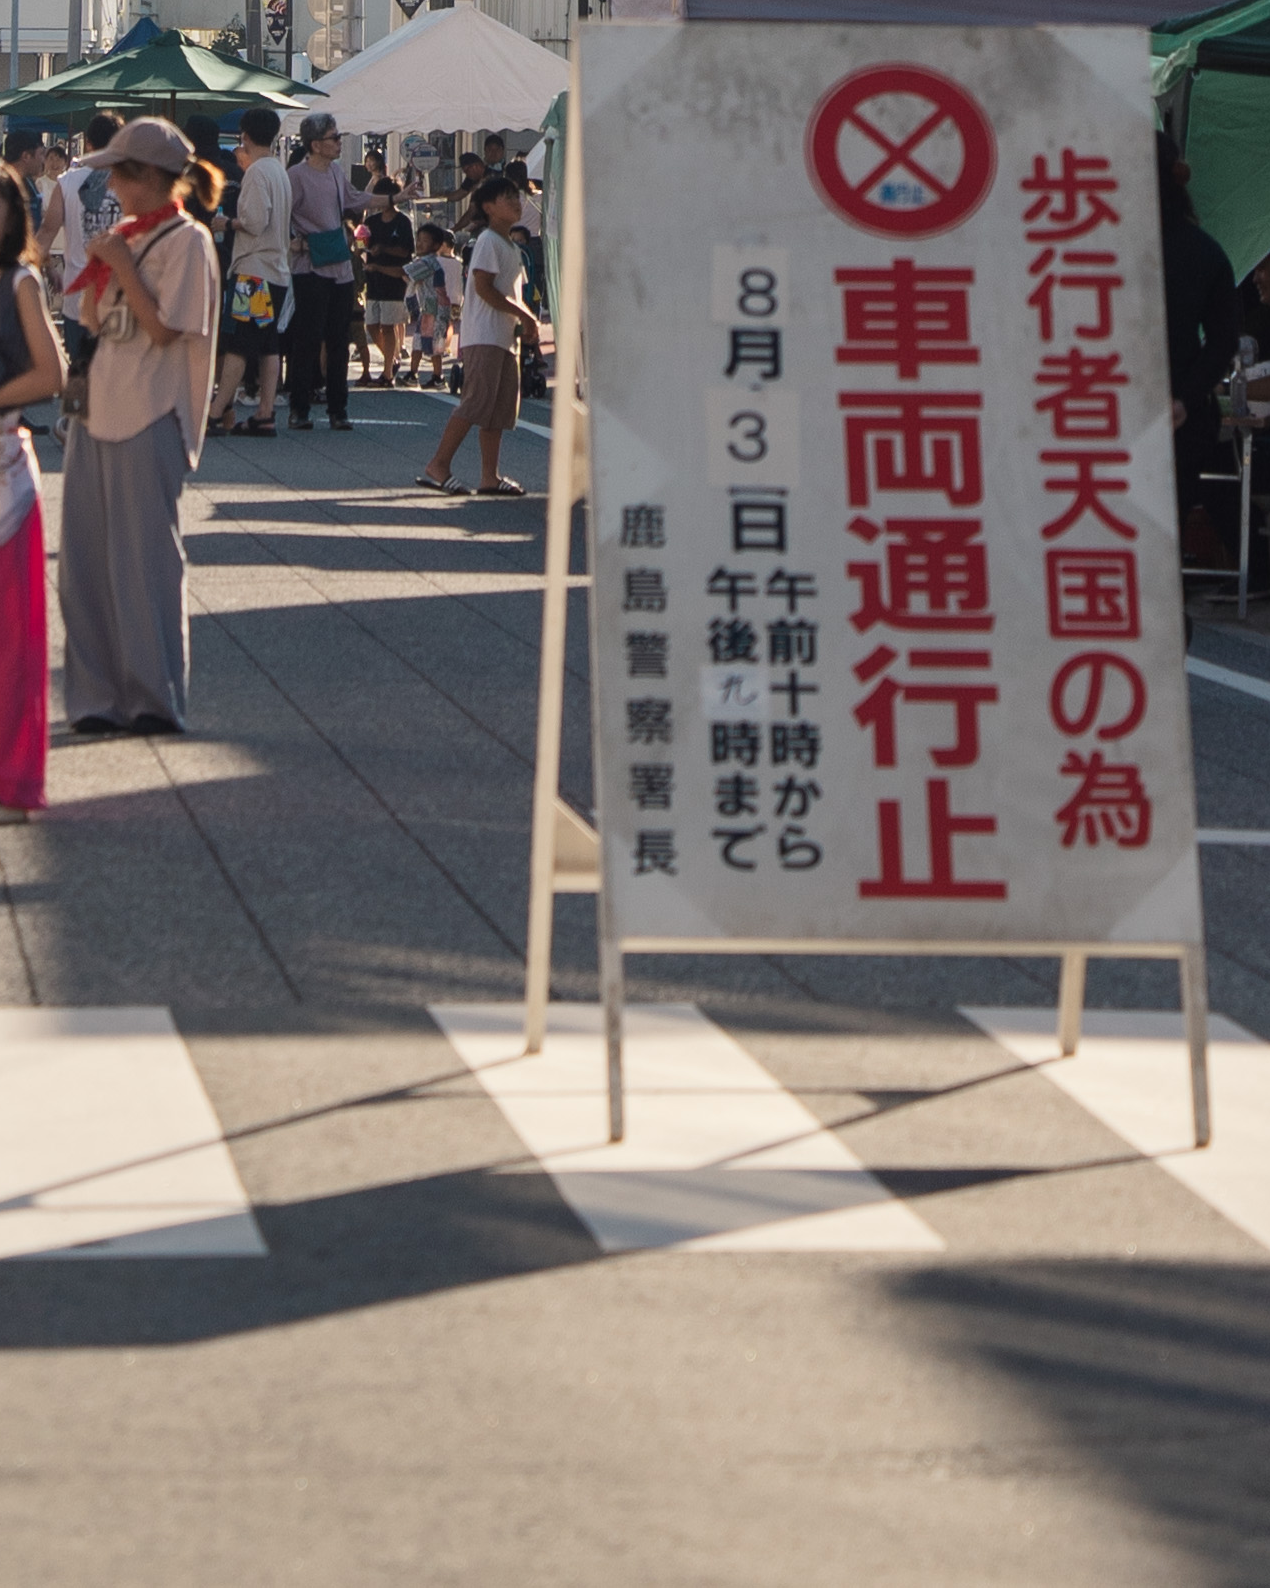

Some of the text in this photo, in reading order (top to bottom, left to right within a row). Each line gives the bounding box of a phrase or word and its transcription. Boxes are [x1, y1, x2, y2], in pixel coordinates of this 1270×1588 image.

[724, 267, 789, 554] 8月3日
[833, 258, 1008, 901] 車両通行止
[1021, 148, 1153, 851] 歩行者天国の為
[620, 503, 678, 878] 鹿島警察署長
[706, 566, 766, 872] 午後九時まで
[765, 567, 823, 872] 午前十時から
